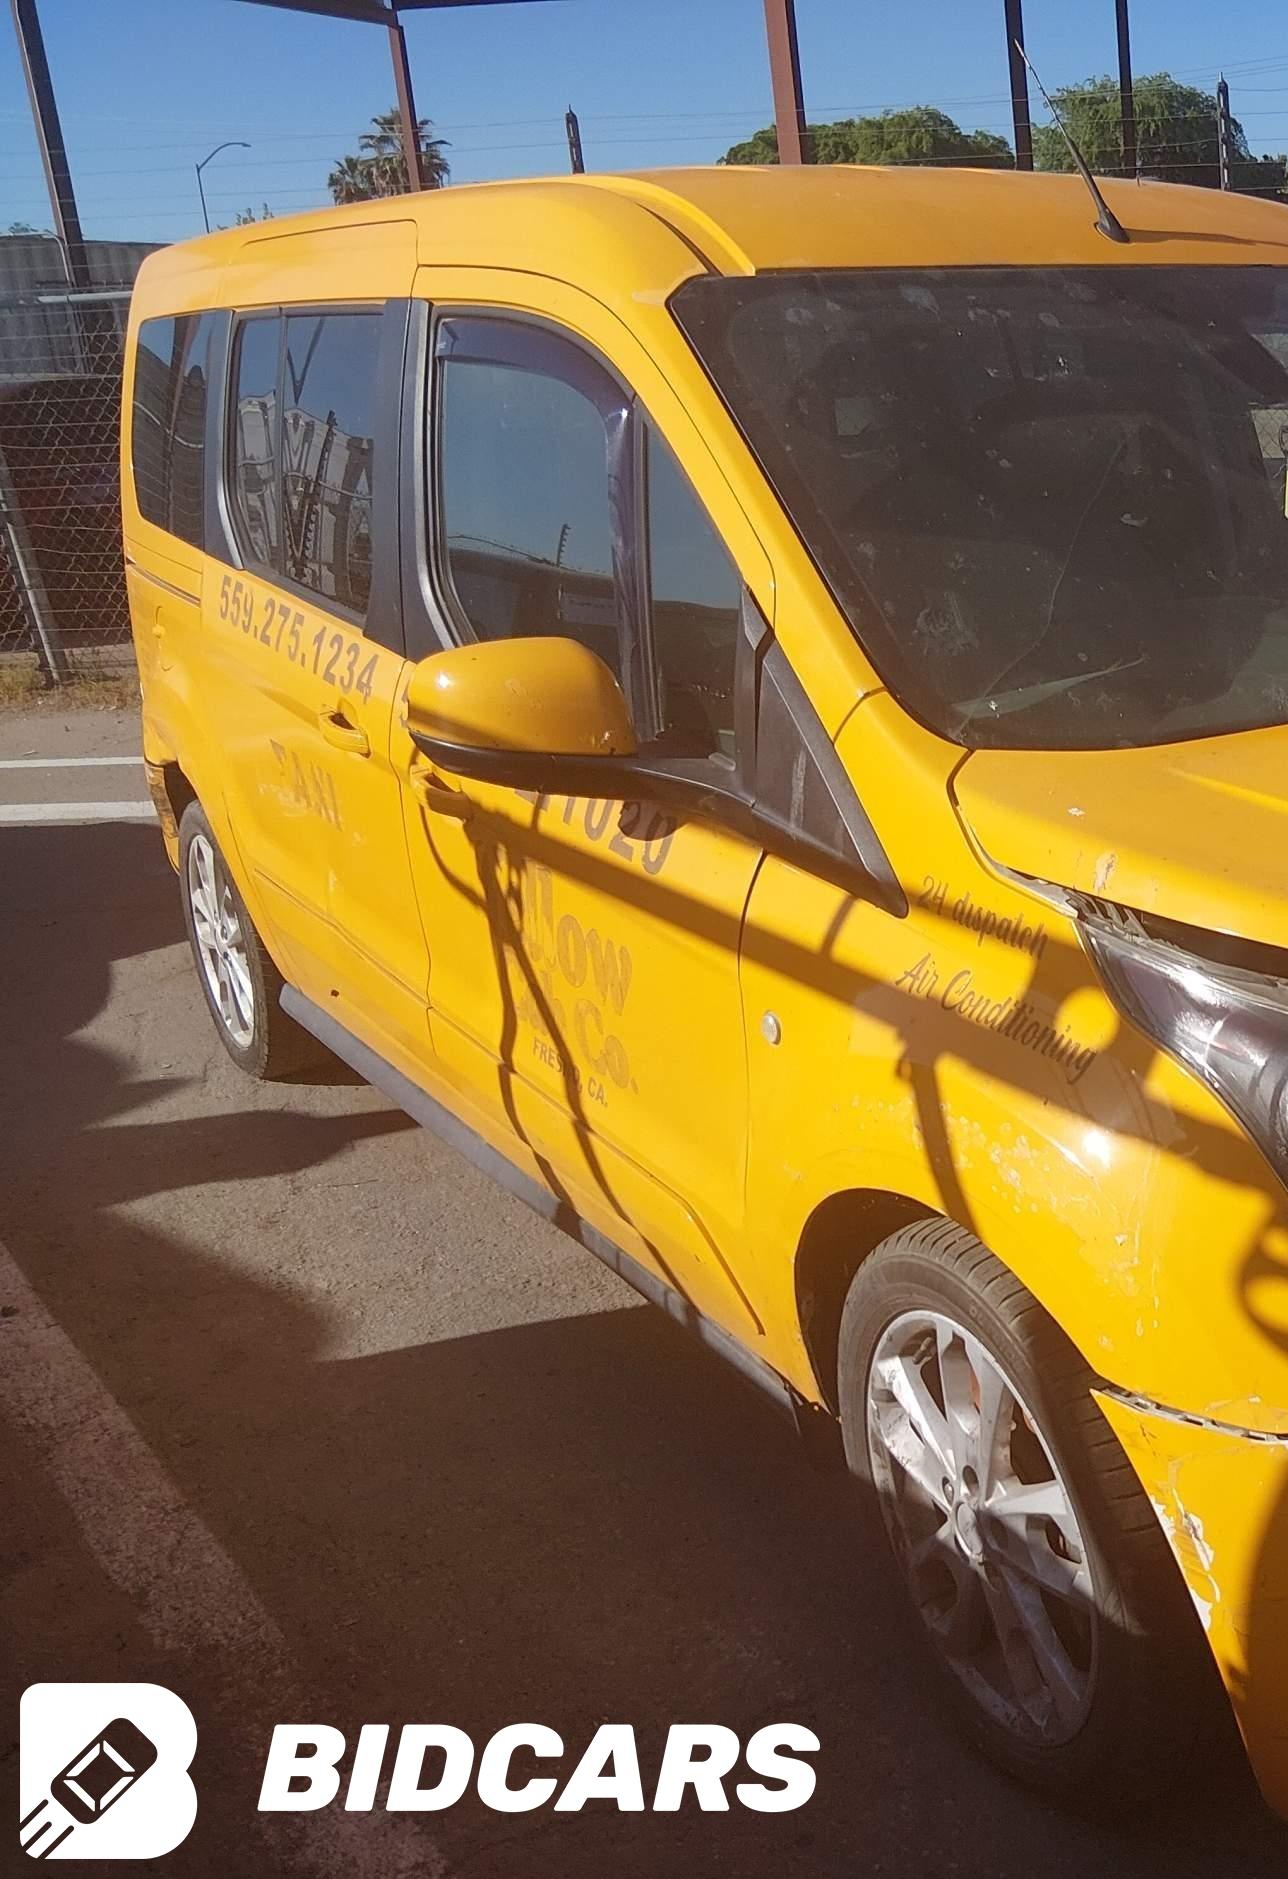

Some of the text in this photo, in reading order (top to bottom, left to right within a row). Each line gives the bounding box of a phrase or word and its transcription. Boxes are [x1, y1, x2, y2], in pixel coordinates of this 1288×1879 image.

[219, 574, 380, 705] 559.275.1234
[895, 952, 1097, 1086] Air Conditioning
